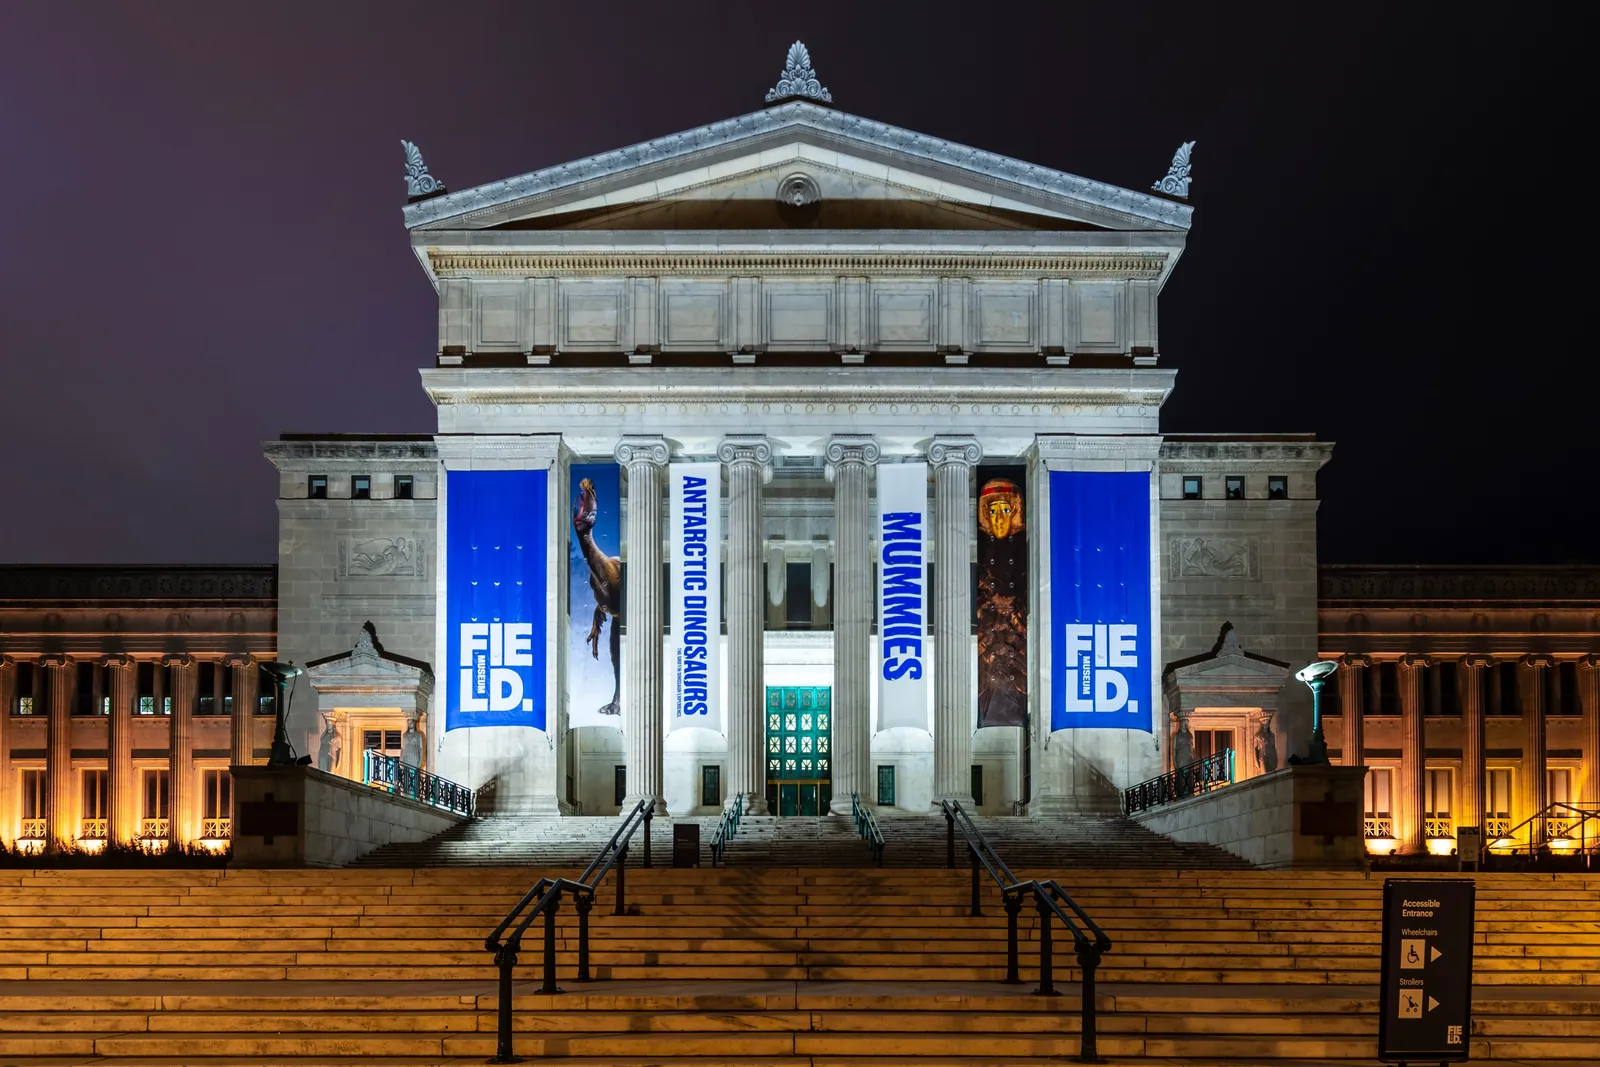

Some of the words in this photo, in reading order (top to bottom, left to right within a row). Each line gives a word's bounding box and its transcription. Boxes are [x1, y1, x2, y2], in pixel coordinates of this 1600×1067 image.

[683, 475, 707, 591] ANTARCTIC
[882, 512, 922, 681] MUMMIES
[477, 655, 486, 694] MUSEUM
[683, 596, 708, 716] DINOSAURS
[1082, 656, 1091, 695] MUSEUM
[1402, 899, 1441, 908] Accessible
[1402, 909, 1434, 917] Entrance
[1401, 928, 1438, 936] Wheelchairs
[1399, 978, 1425, 986] Strollers
